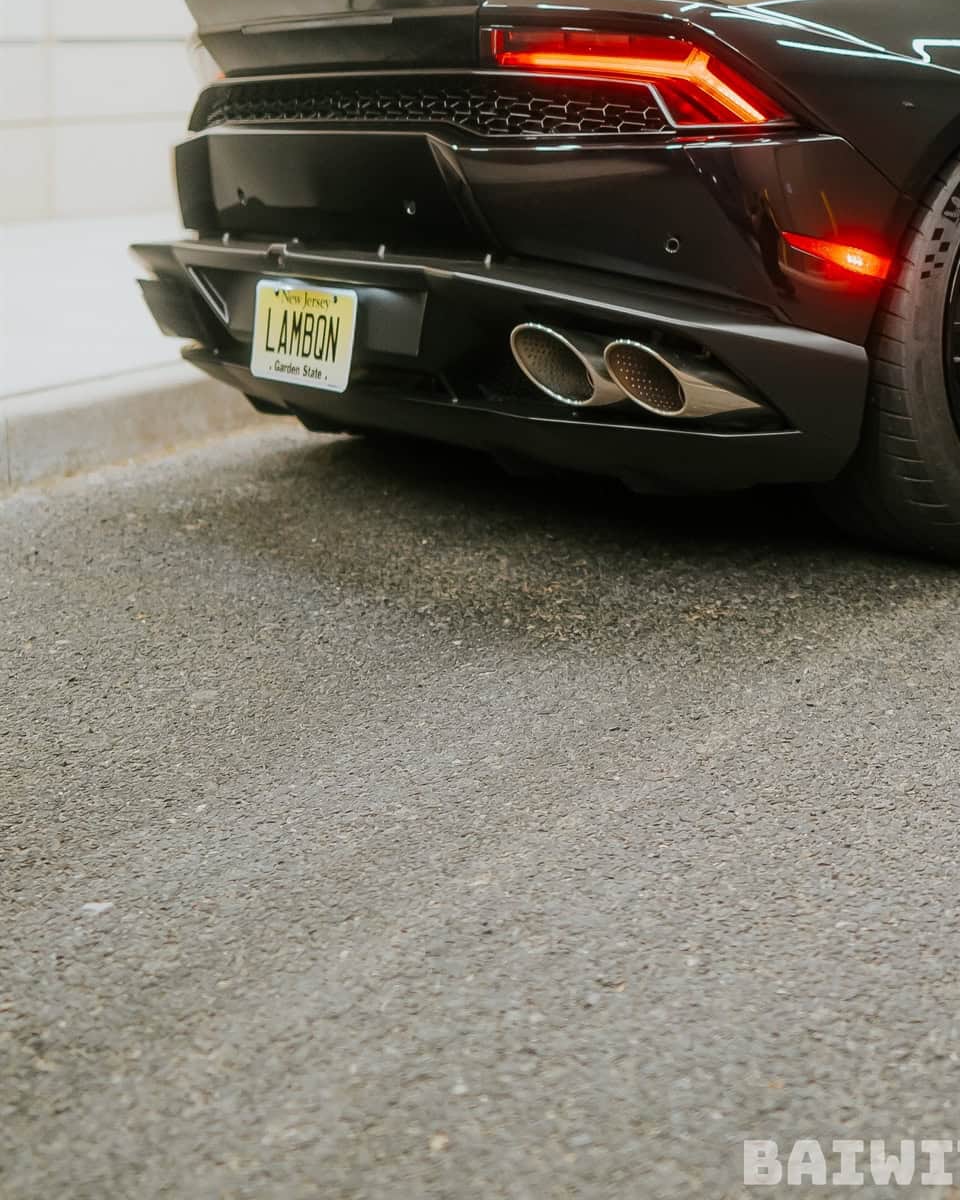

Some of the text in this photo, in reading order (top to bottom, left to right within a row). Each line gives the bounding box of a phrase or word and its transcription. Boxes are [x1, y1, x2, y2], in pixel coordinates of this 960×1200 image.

[281, 289, 330, 311] New Jersey
[274, 359, 322, 380] Garden State
